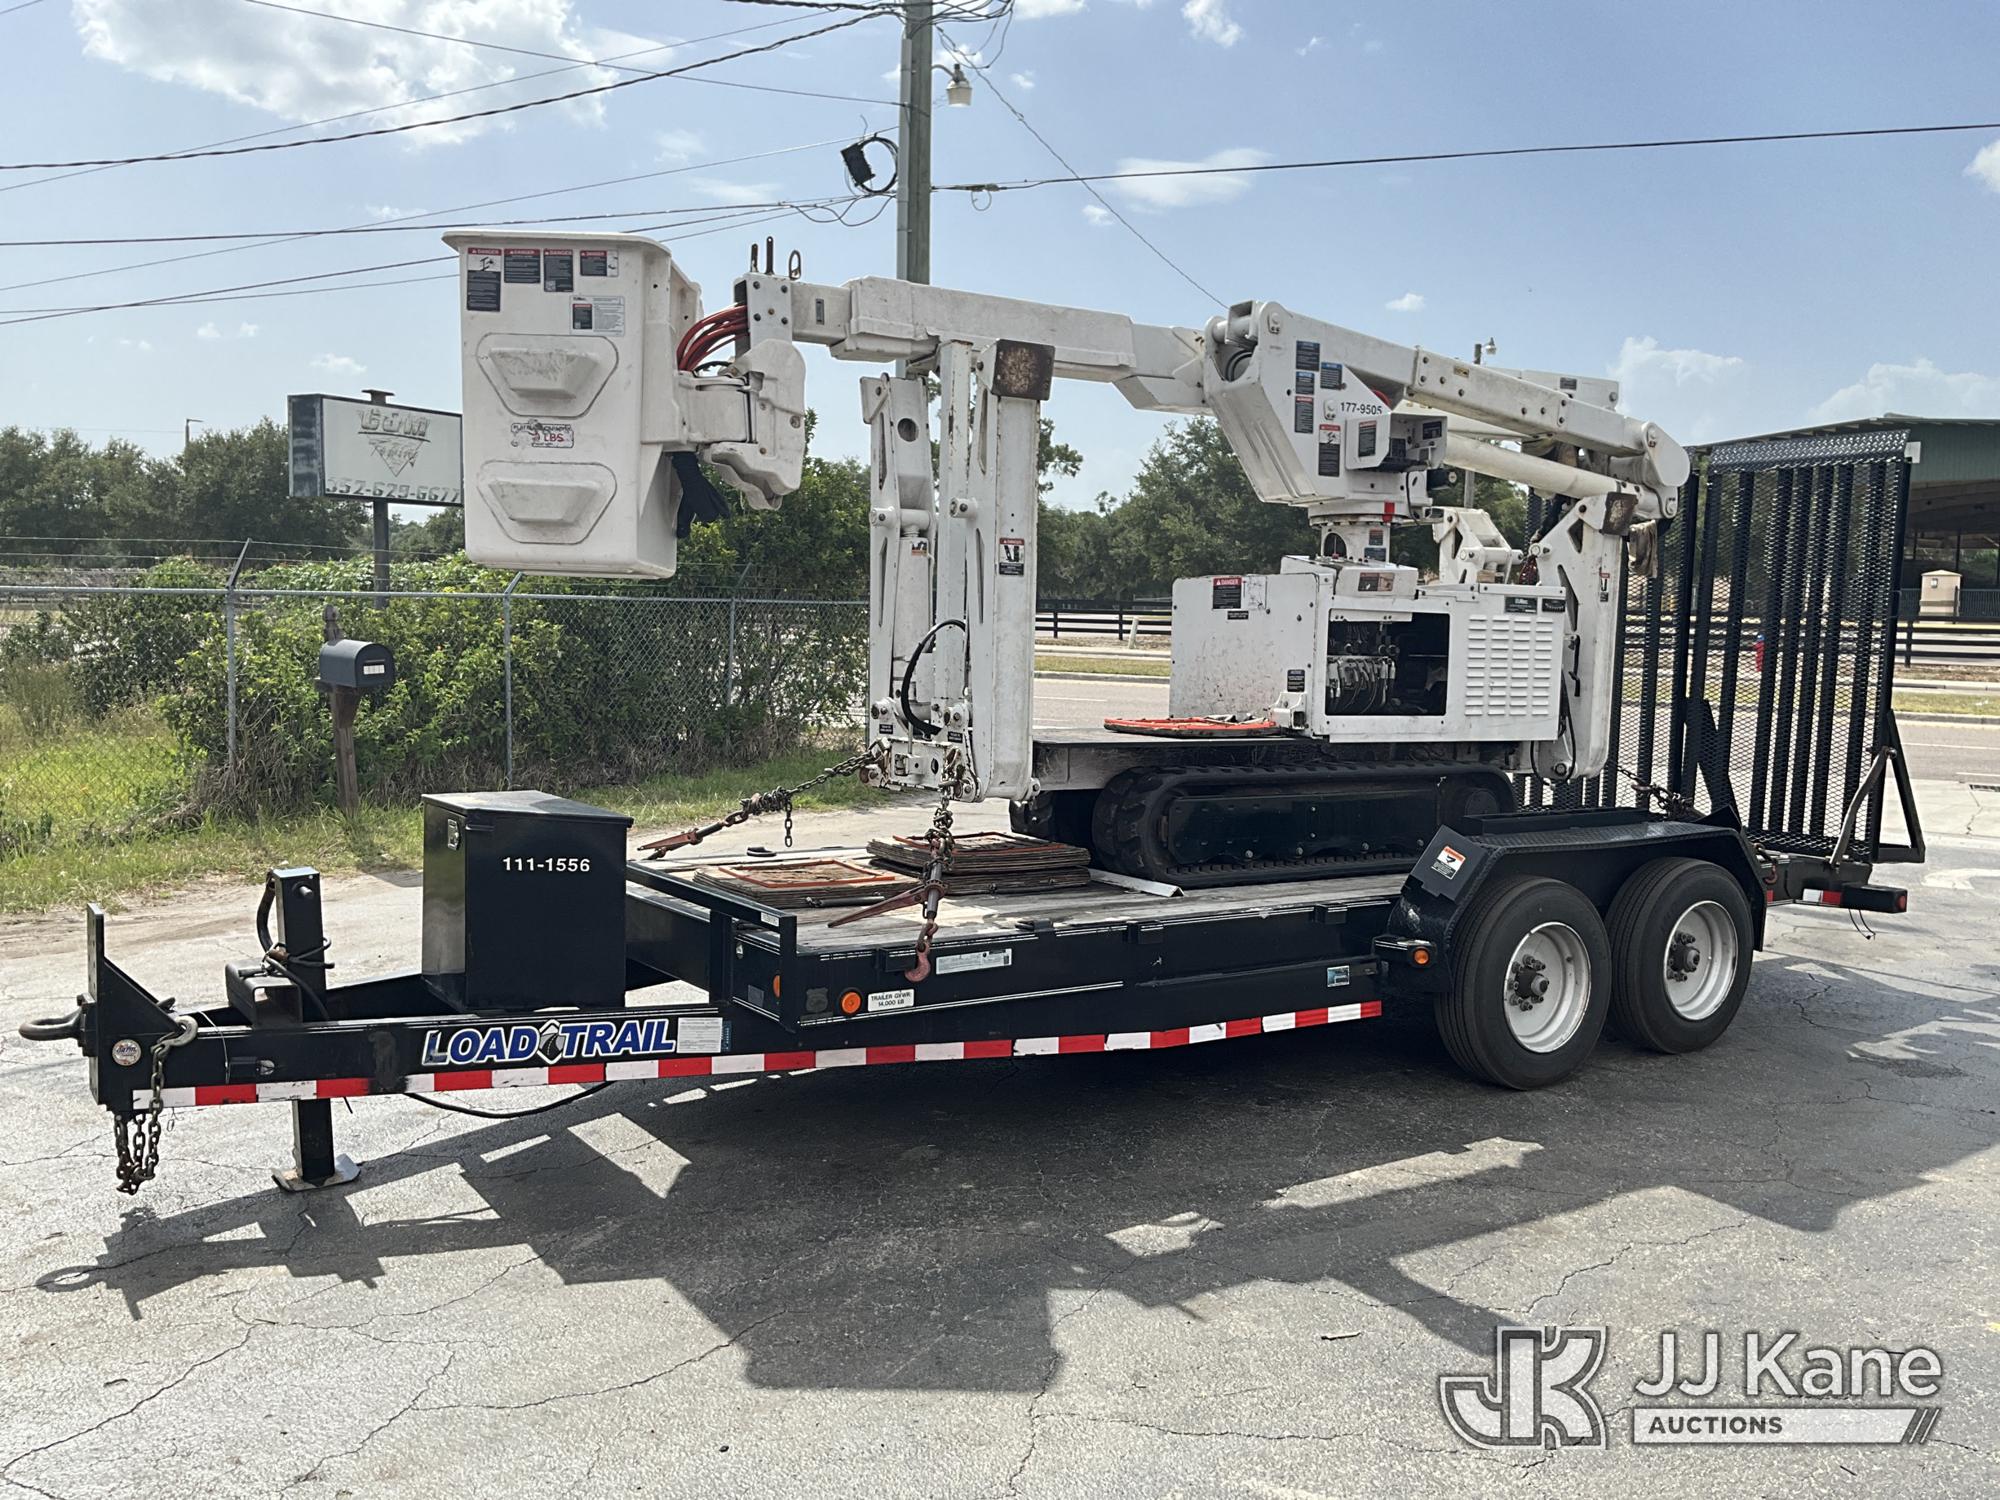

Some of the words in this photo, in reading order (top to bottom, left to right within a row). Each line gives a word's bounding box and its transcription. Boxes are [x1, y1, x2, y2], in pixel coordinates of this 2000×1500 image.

[1340, 402, 1383, 415] 177-9505
[544, 433, 565, 442] LBS
[502, 857, 590, 872] 111-1556
[421, 1025, 540, 1066] LOAD
[559, 1019, 675, 1058] TRAIL
